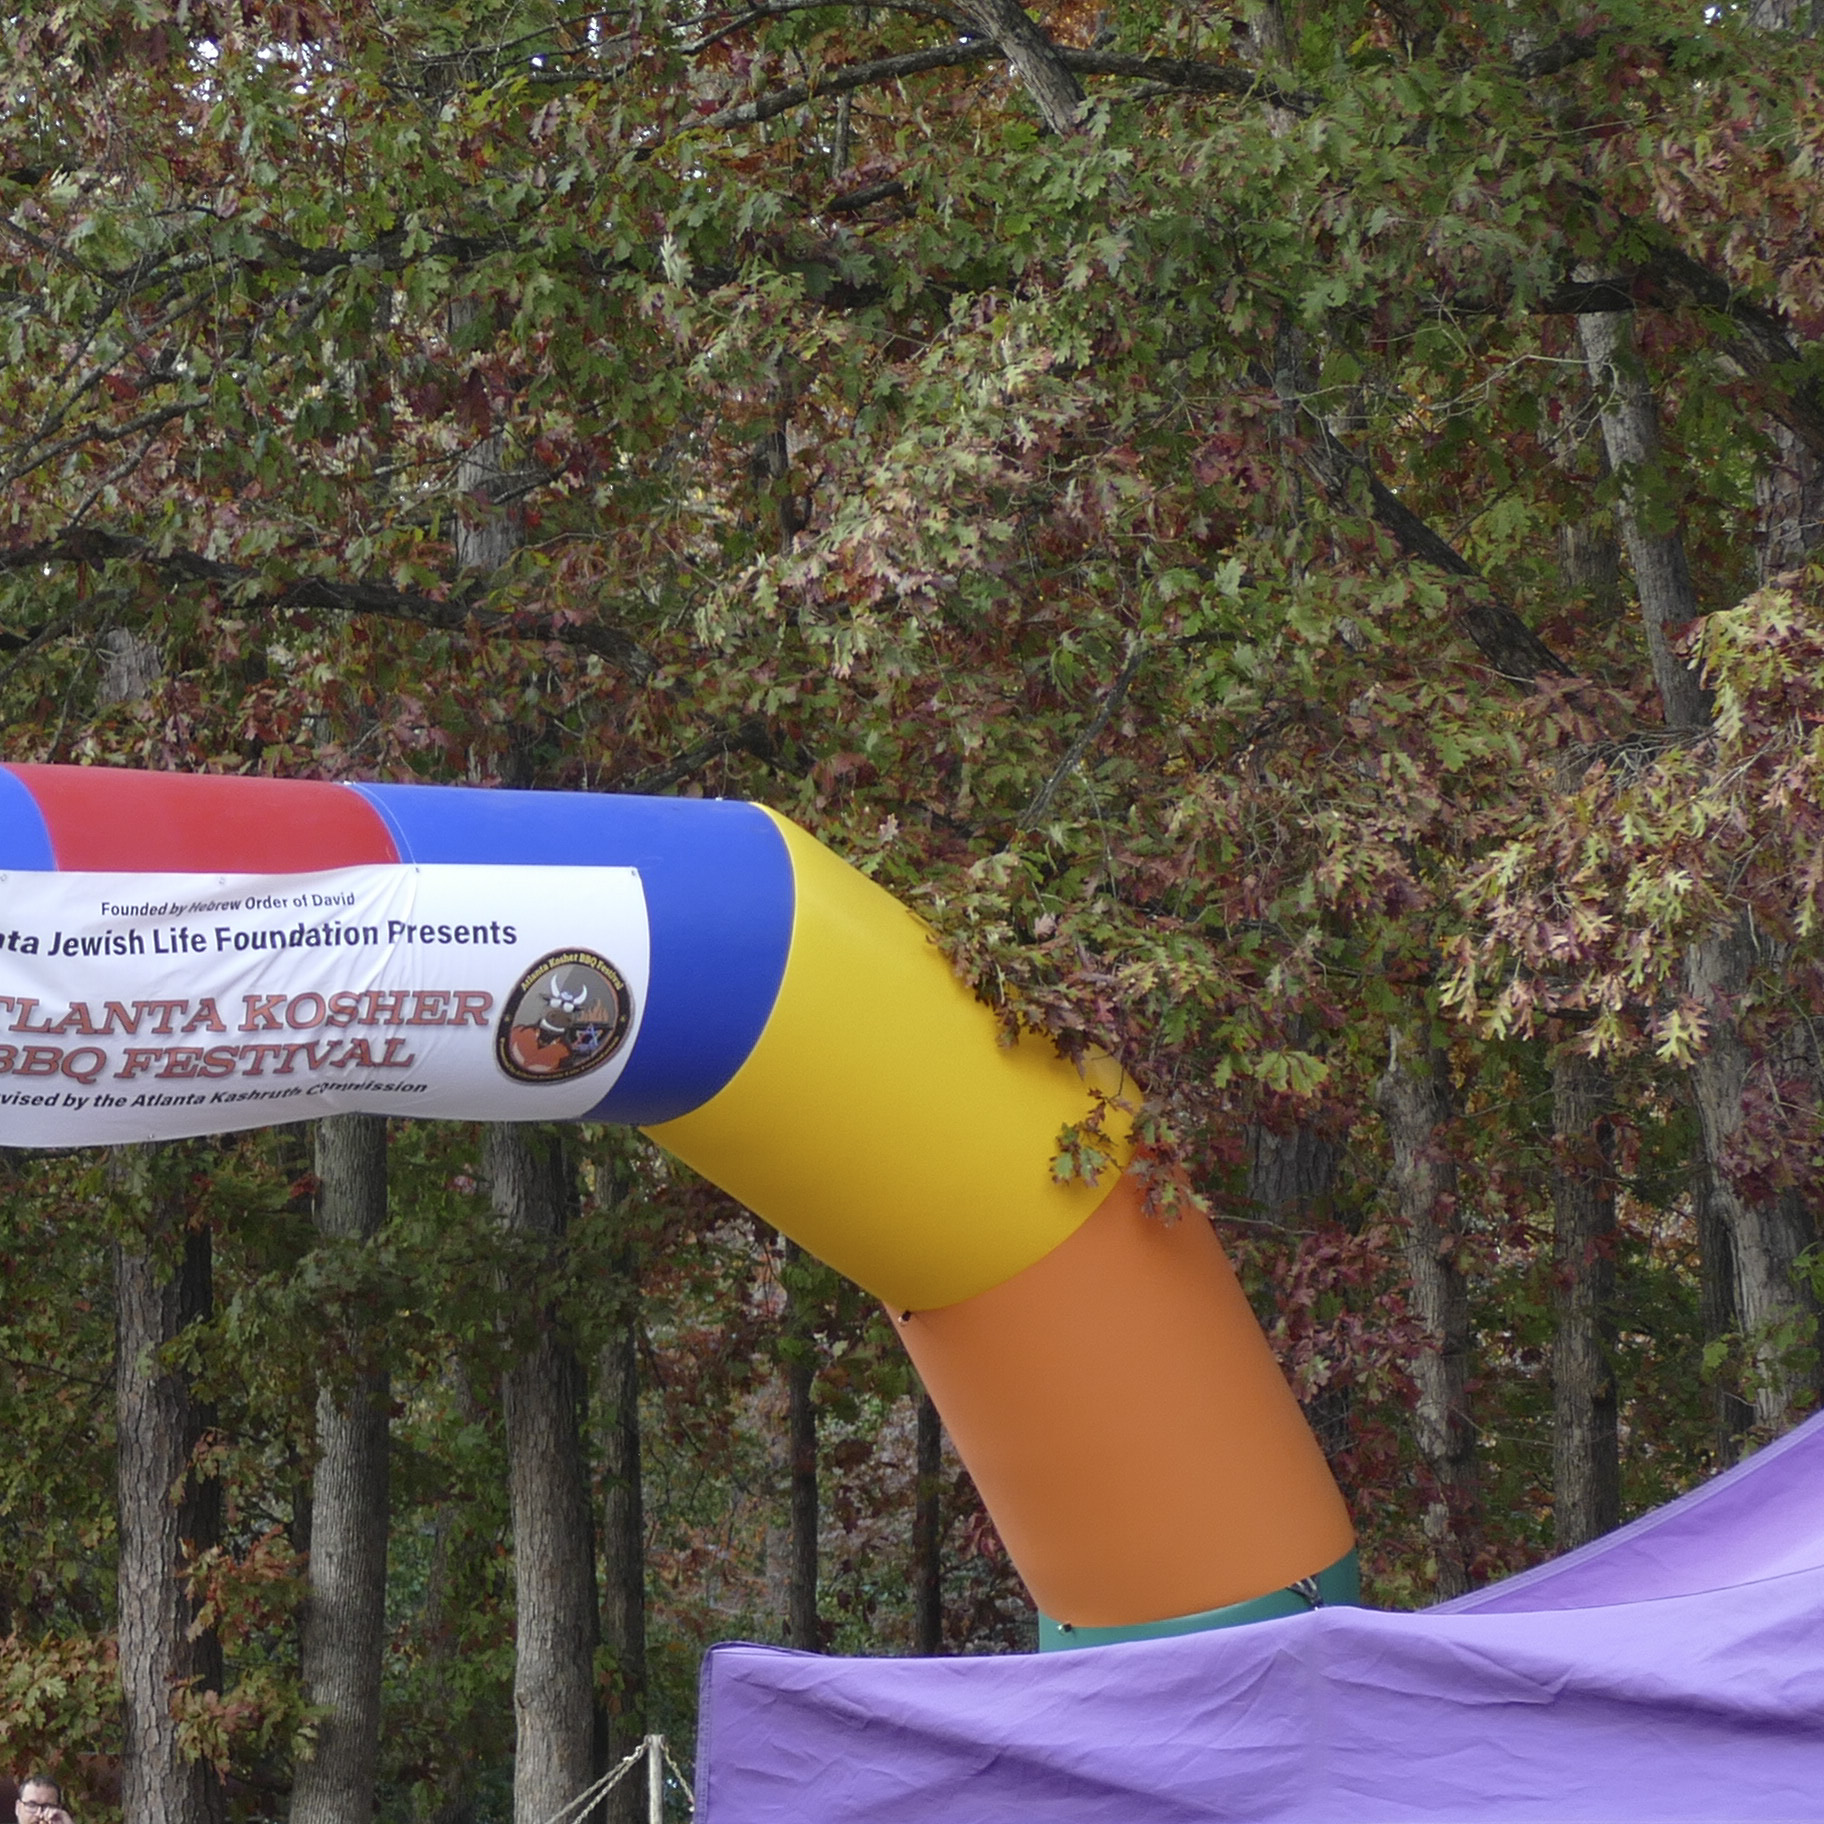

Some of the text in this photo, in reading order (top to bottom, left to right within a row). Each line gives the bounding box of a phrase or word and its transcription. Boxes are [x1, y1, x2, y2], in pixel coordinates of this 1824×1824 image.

[102, 892, 355, 917] Founded by Hebrew Order of David
[47, 929, 145, 956] Jewish
[153, 927, 208, 954] Life
[215, 921, 378, 951] Foundation
[387, 920, 517, 945] Presents
[238, 990, 494, 1031] KOSHER
[113, 1038, 416, 1078] FESTIVAL
[63, 1093, 89, 1110] by
[94, 1094, 127, 1107] the
[130, 1092, 204, 1107] Atlanta
[210, 1086, 303, 1104] Kashruth
[306, 1080, 428, 1096] Commission
